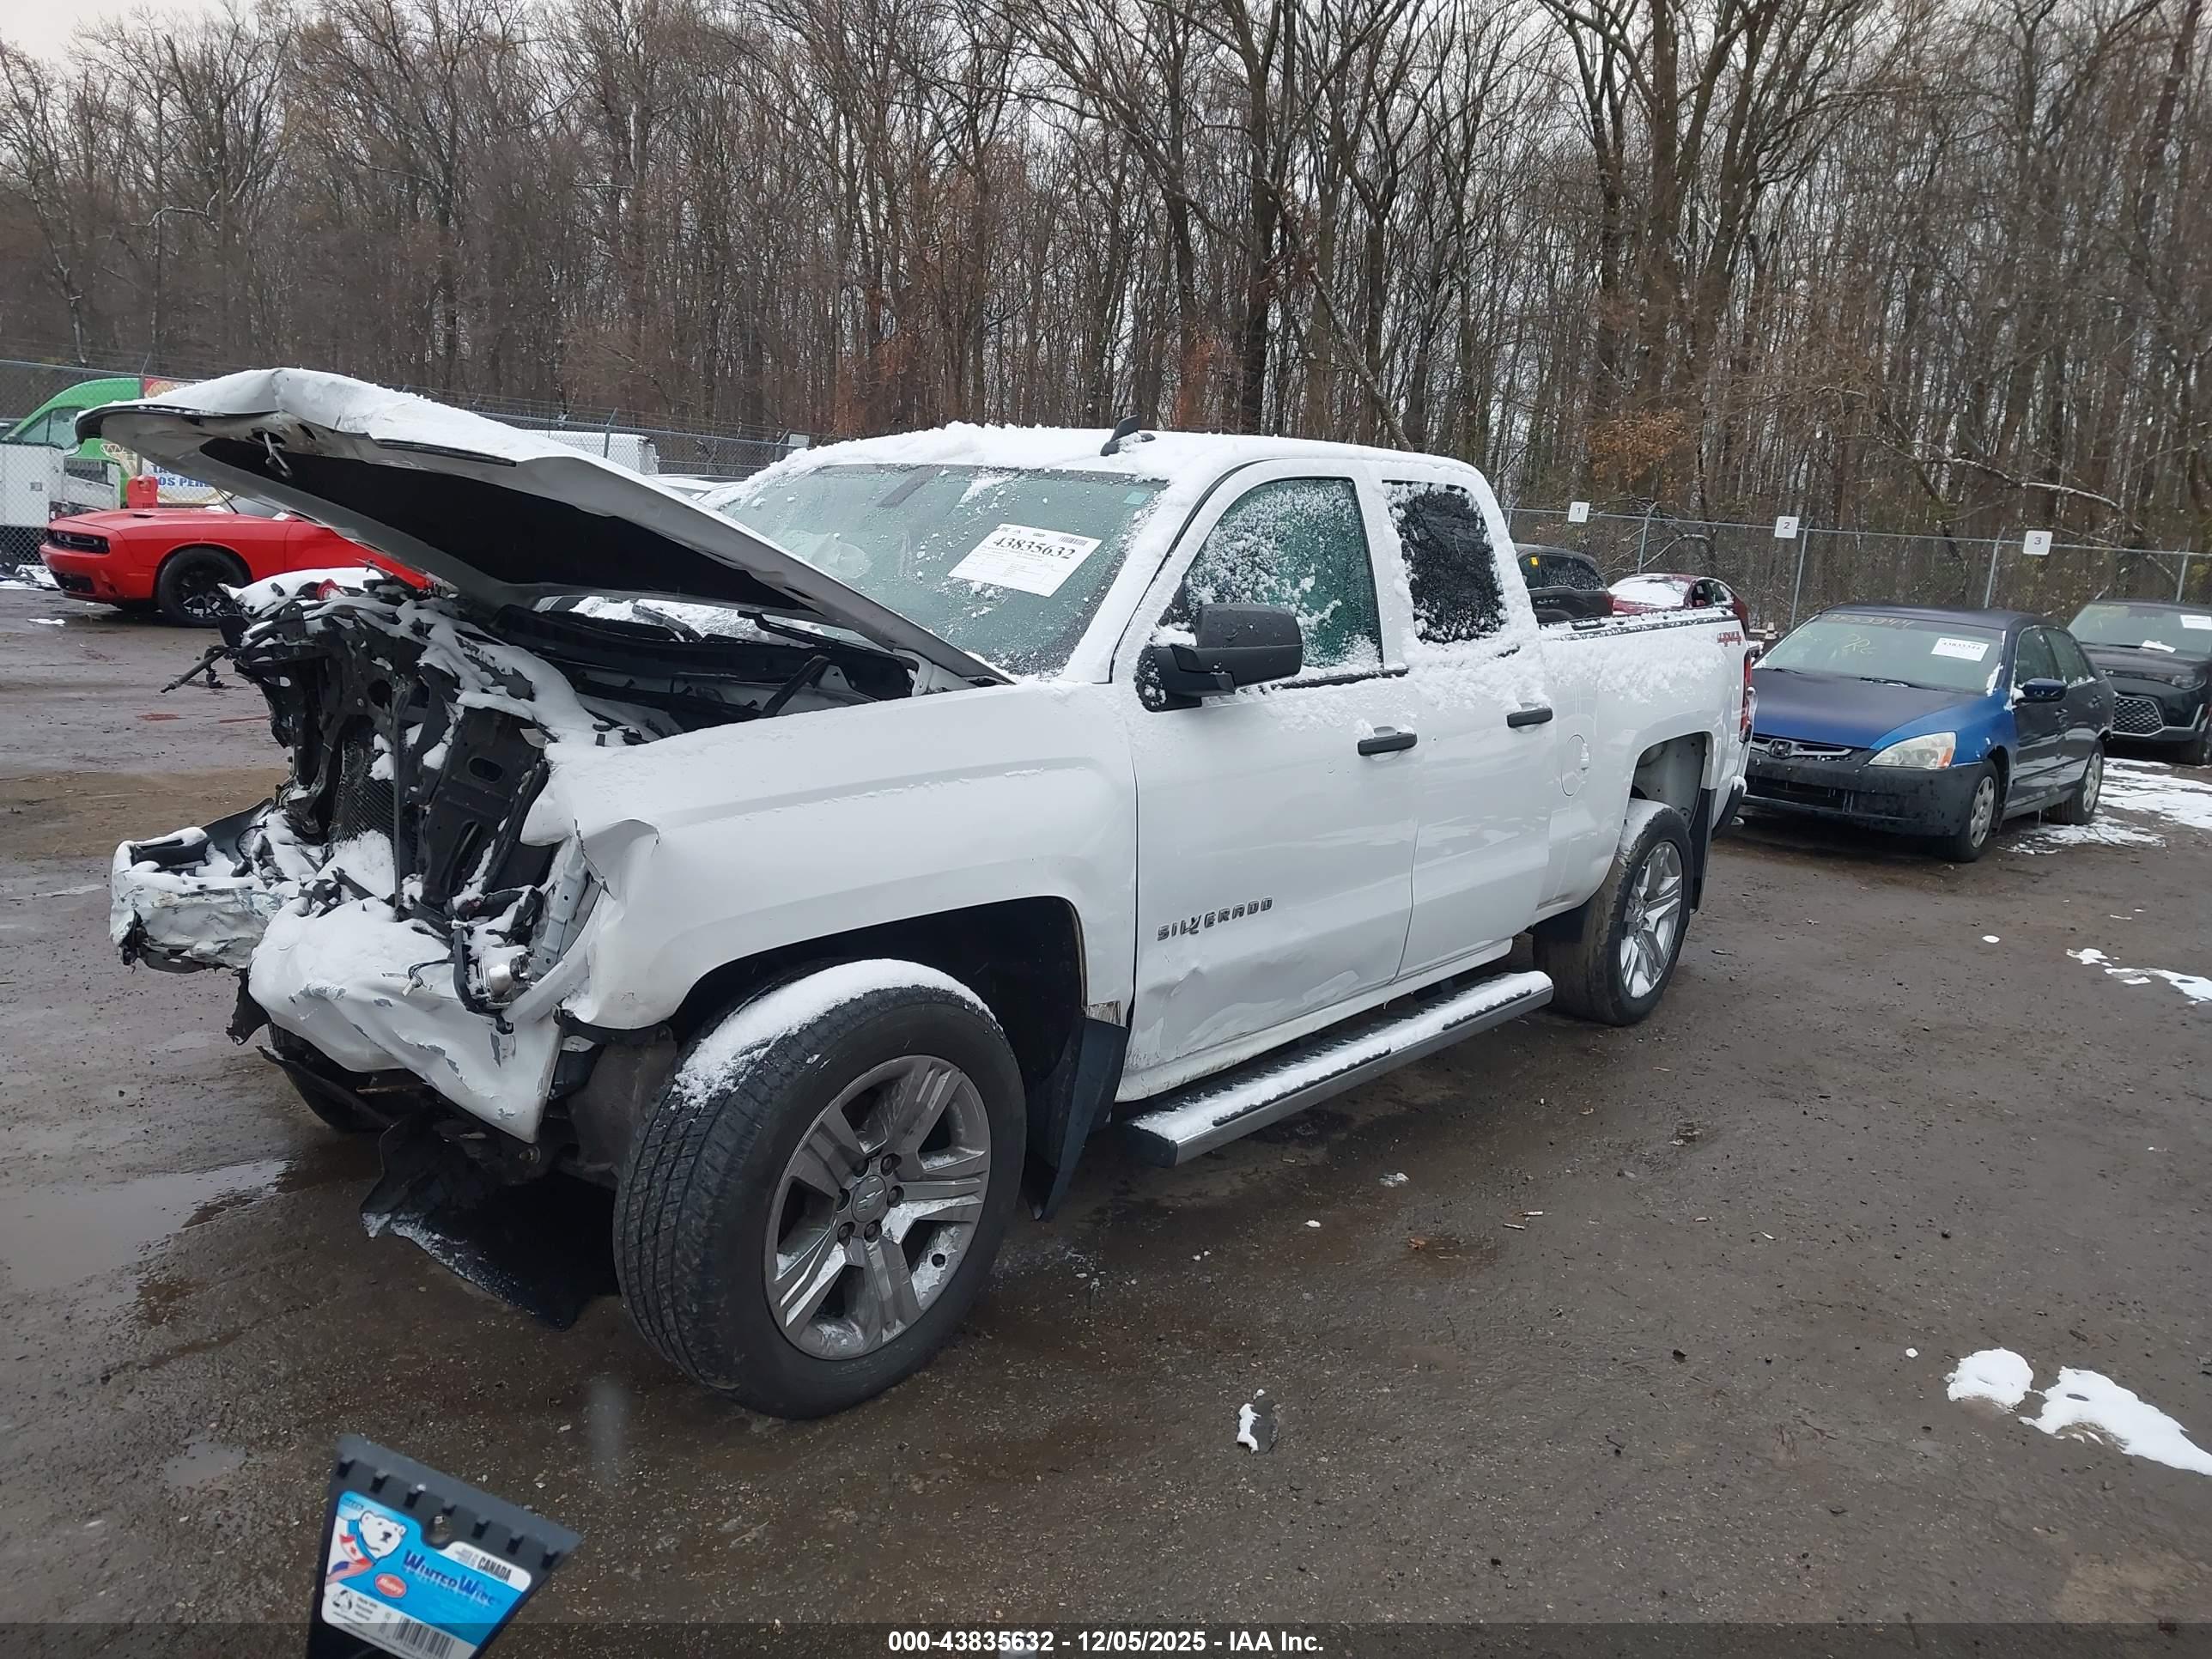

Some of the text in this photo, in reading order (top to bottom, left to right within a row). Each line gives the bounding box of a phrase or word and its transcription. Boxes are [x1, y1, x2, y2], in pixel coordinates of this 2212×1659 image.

[1783, 521, 1790, 530] 2
[994, 537, 1076, 559] 43835632
[2033, 537, 2042, 545] 3
[1157, 896, 1273, 942] SILVERADO
[477, 1556, 512, 1583] CANADA
